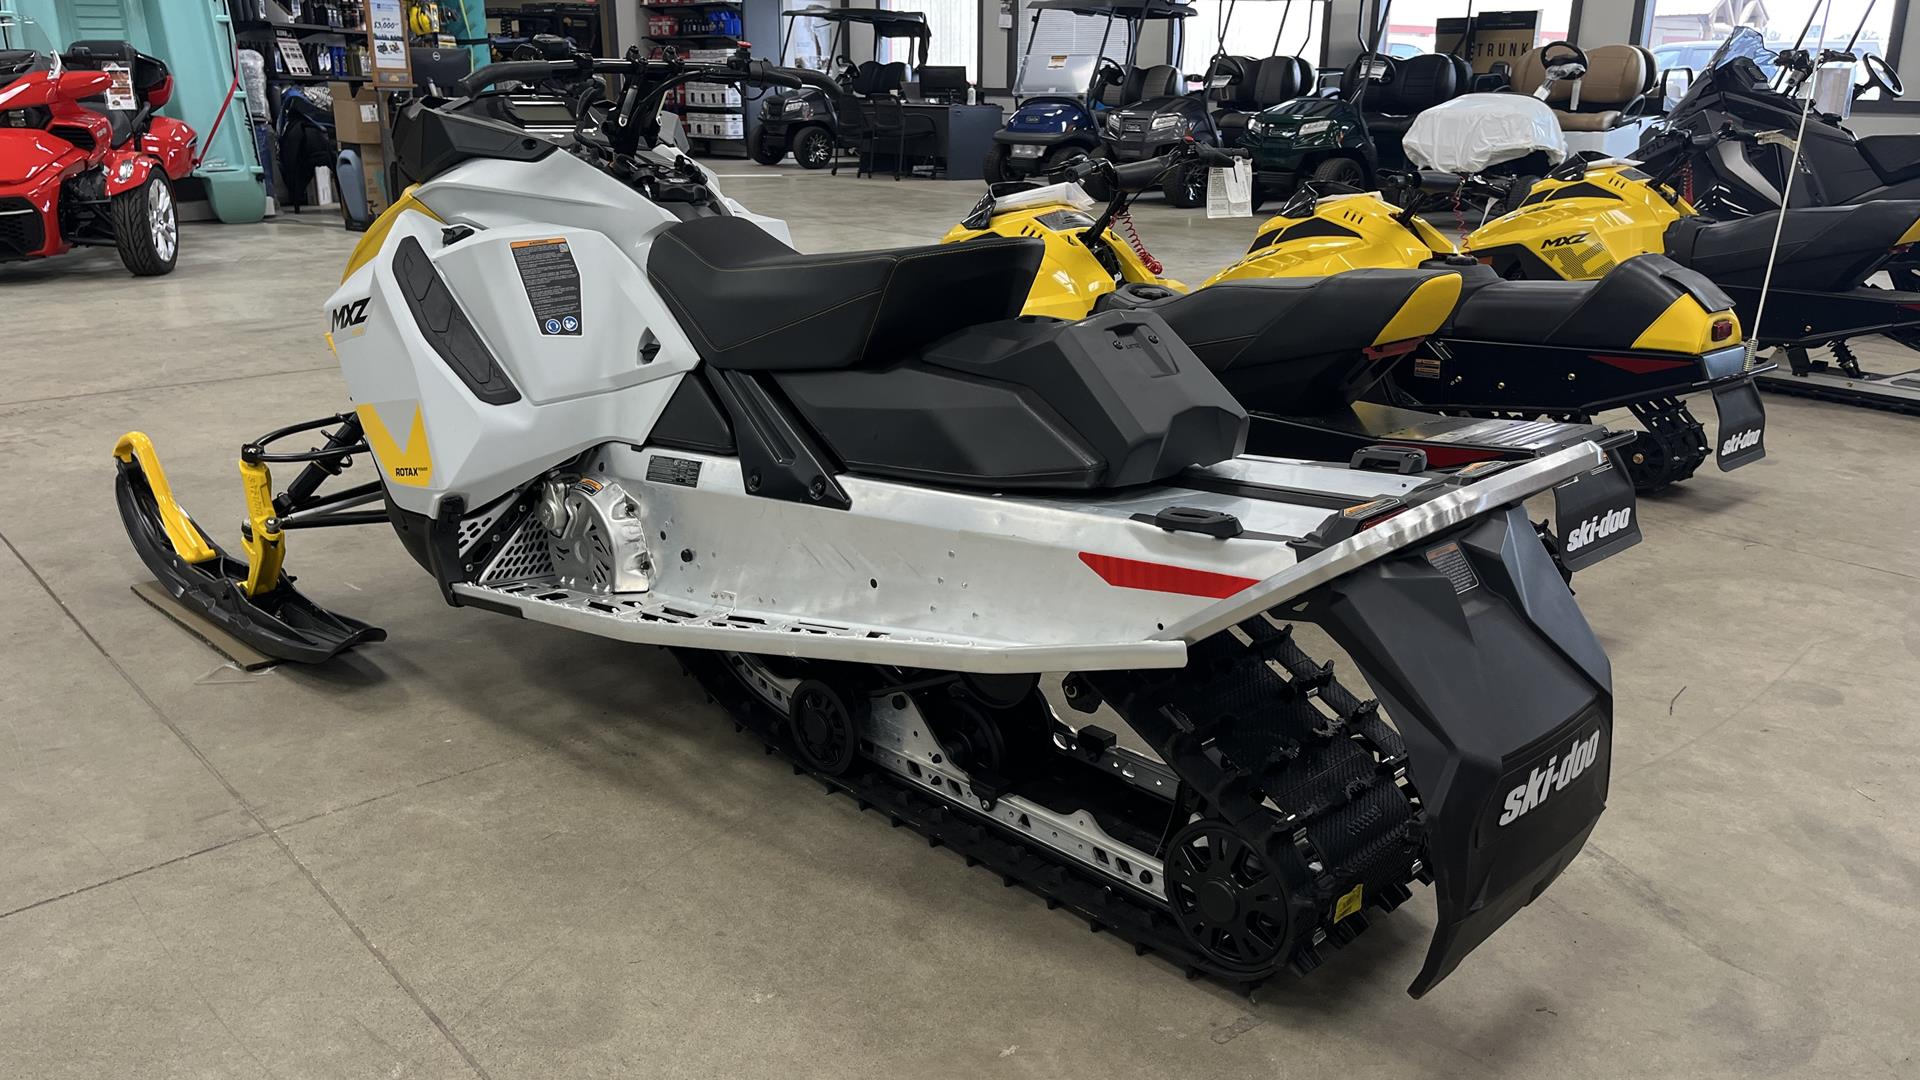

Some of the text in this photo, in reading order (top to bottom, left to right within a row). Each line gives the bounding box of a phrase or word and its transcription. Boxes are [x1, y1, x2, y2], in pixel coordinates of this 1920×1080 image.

[1540, 232, 1591, 250] MXZ
[331, 296, 372, 333] MXZ
[1721, 429, 1761, 456] ski-doo
[395, 467, 419, 477] ROTAX
[1566, 507, 1631, 552] ski-doo
[1498, 729, 1601, 827] ski-doo
